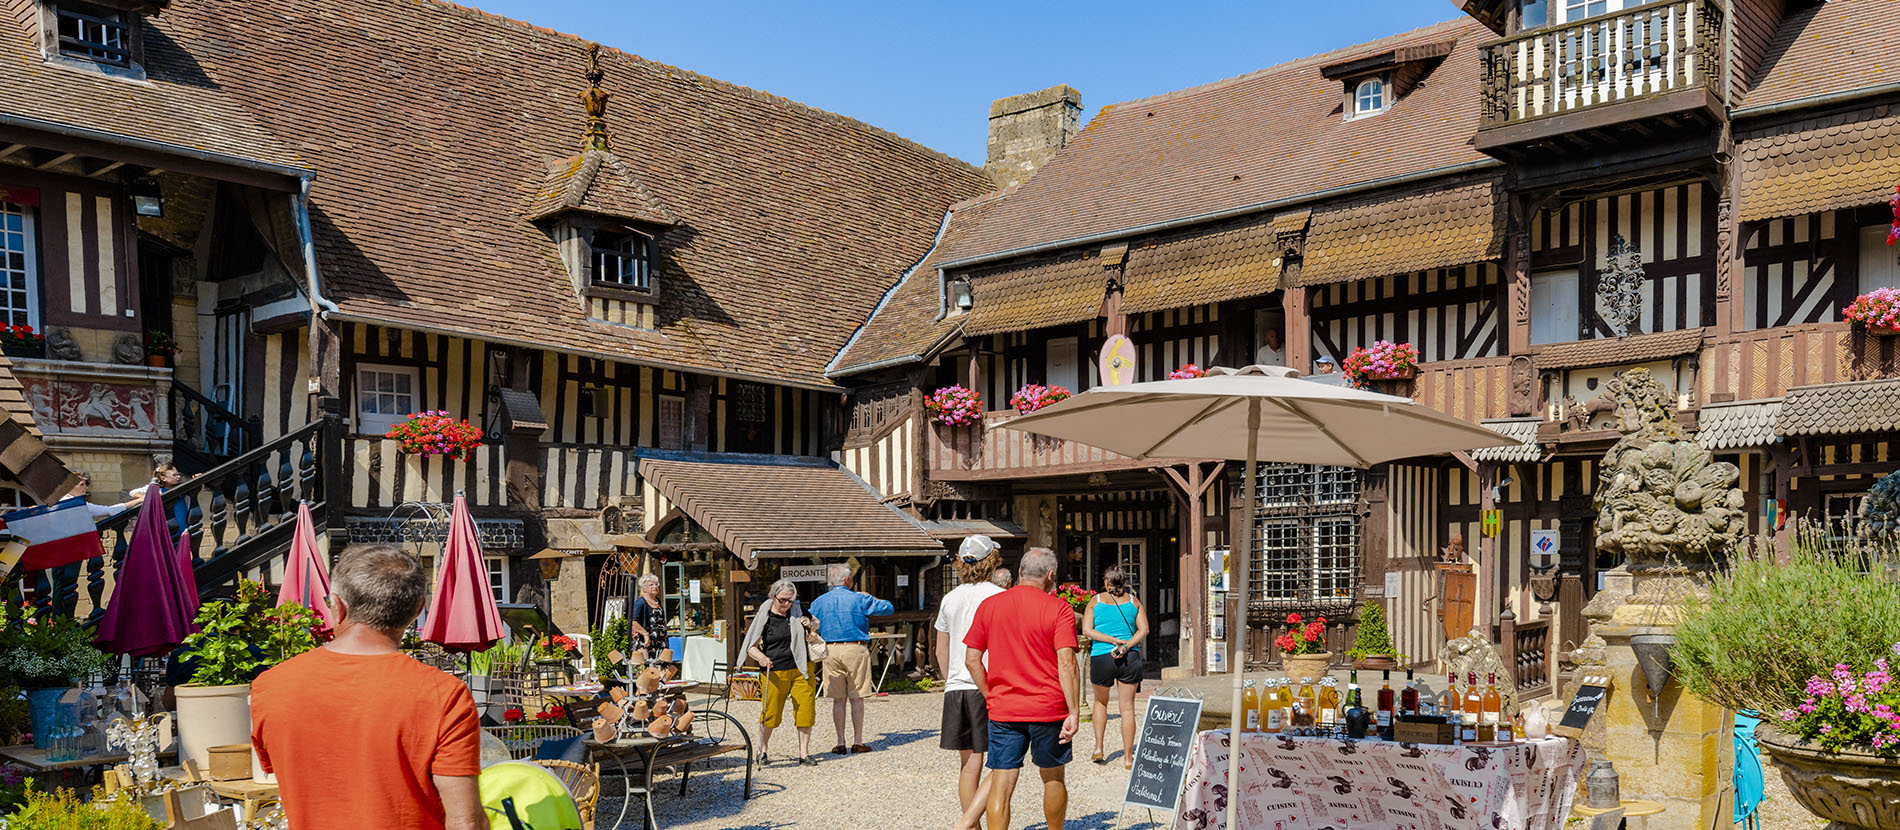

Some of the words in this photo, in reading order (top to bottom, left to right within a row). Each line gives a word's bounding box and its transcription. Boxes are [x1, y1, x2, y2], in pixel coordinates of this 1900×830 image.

[782, 569, 825, 578] BROCANTE
[1396, 763, 1425, 772] CUISINE
[1450, 778, 1483, 788] CUISINE
[1266, 802, 1298, 811] CUISINE
[1388, 808, 1417, 819] CUISINE
